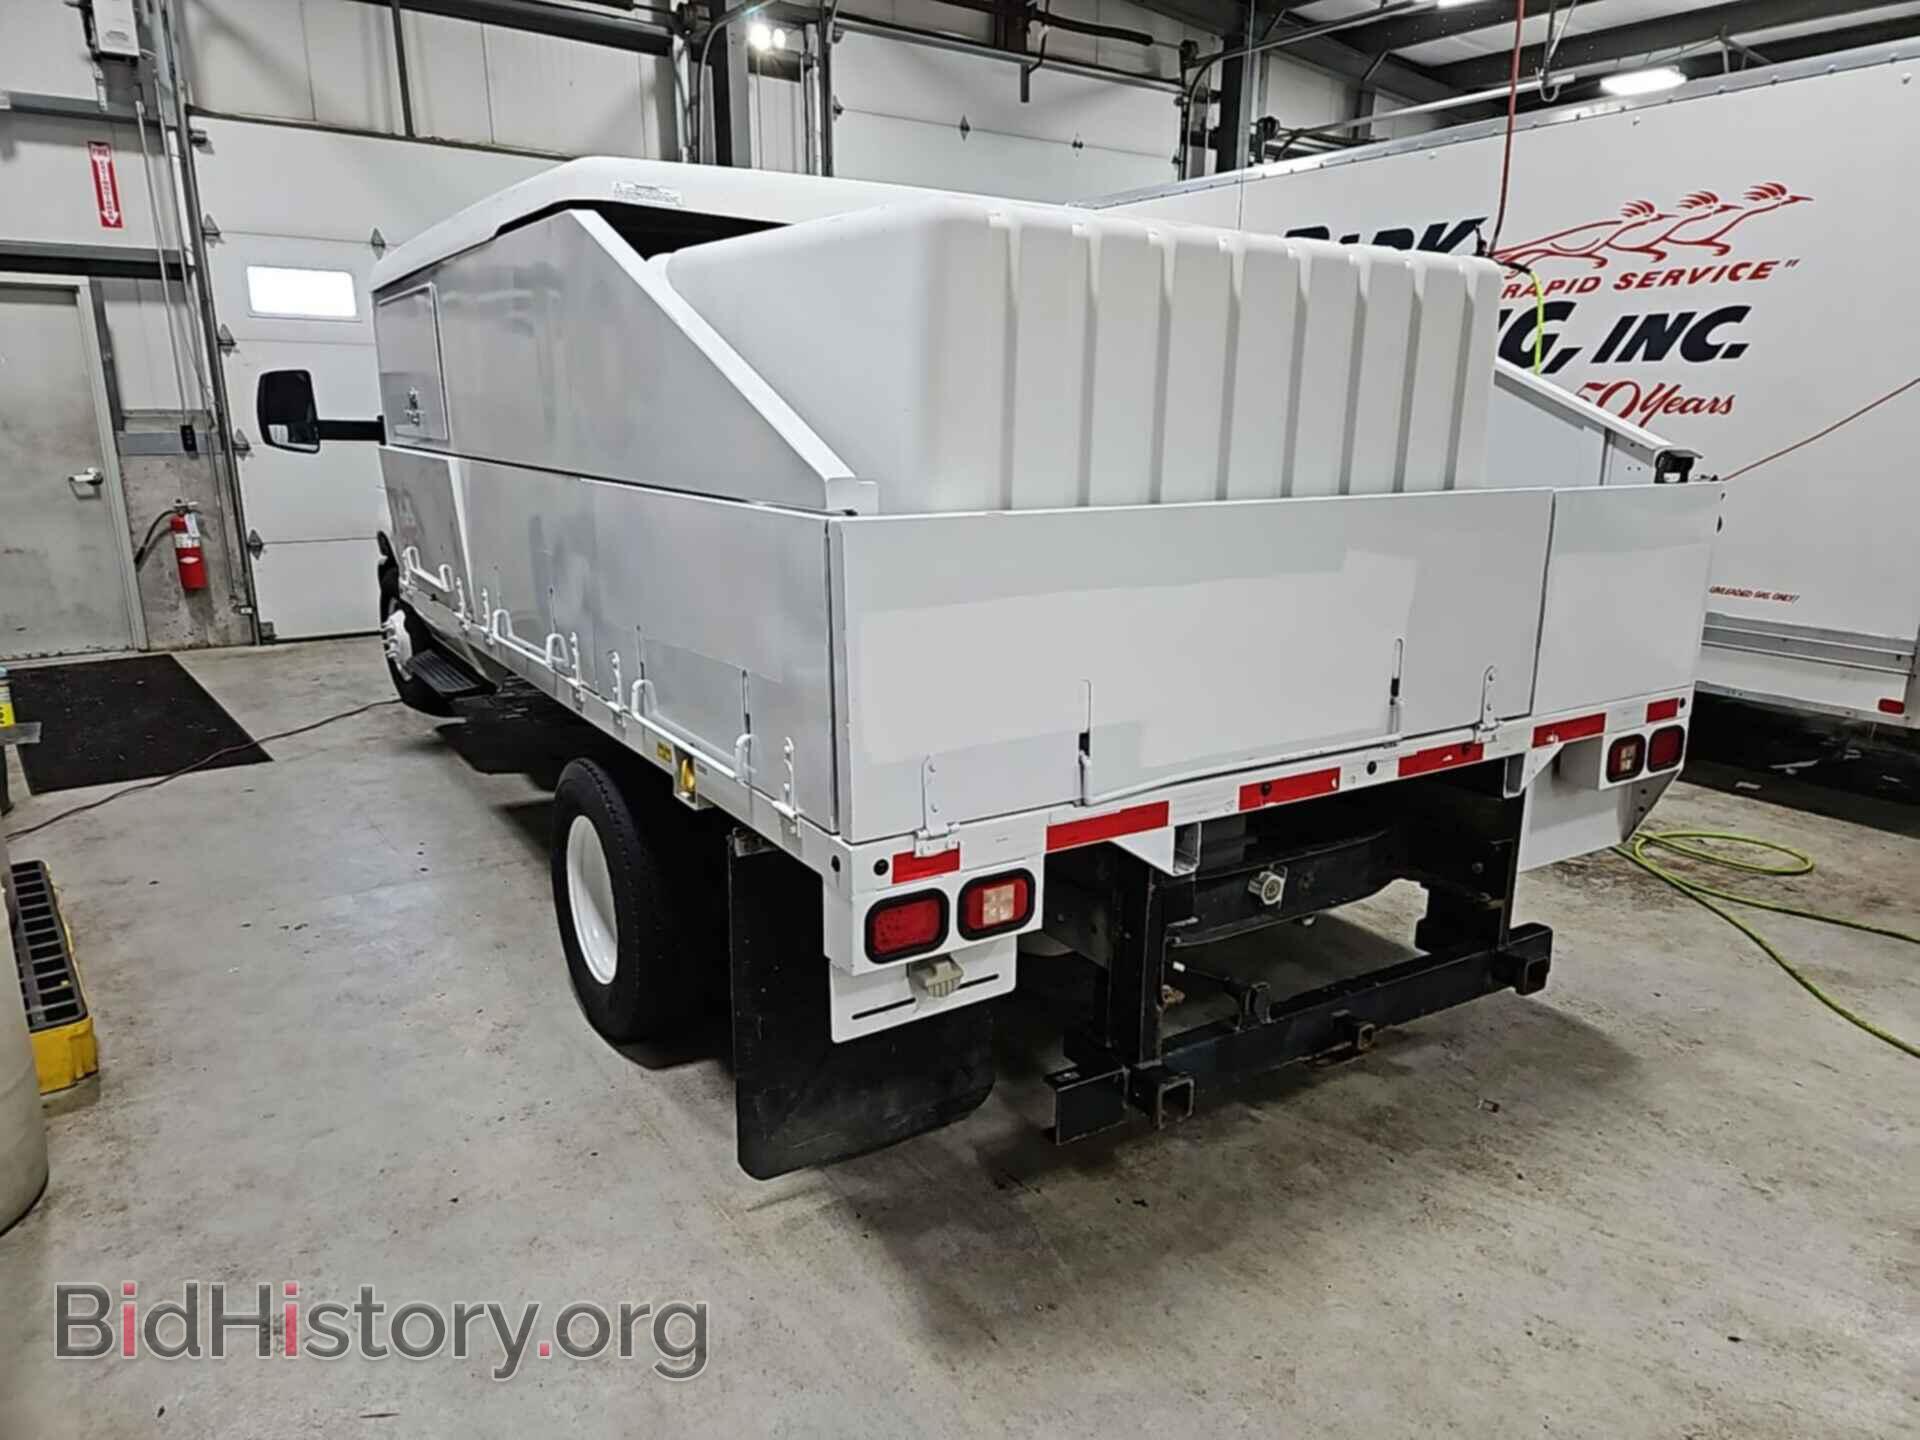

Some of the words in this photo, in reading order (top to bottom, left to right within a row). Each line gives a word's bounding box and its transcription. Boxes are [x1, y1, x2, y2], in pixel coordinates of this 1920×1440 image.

[1501, 276, 1601, 299] RAPID
[1590, 305, 1752, 363] INC.
[1638, 382, 1736, 428] Years
